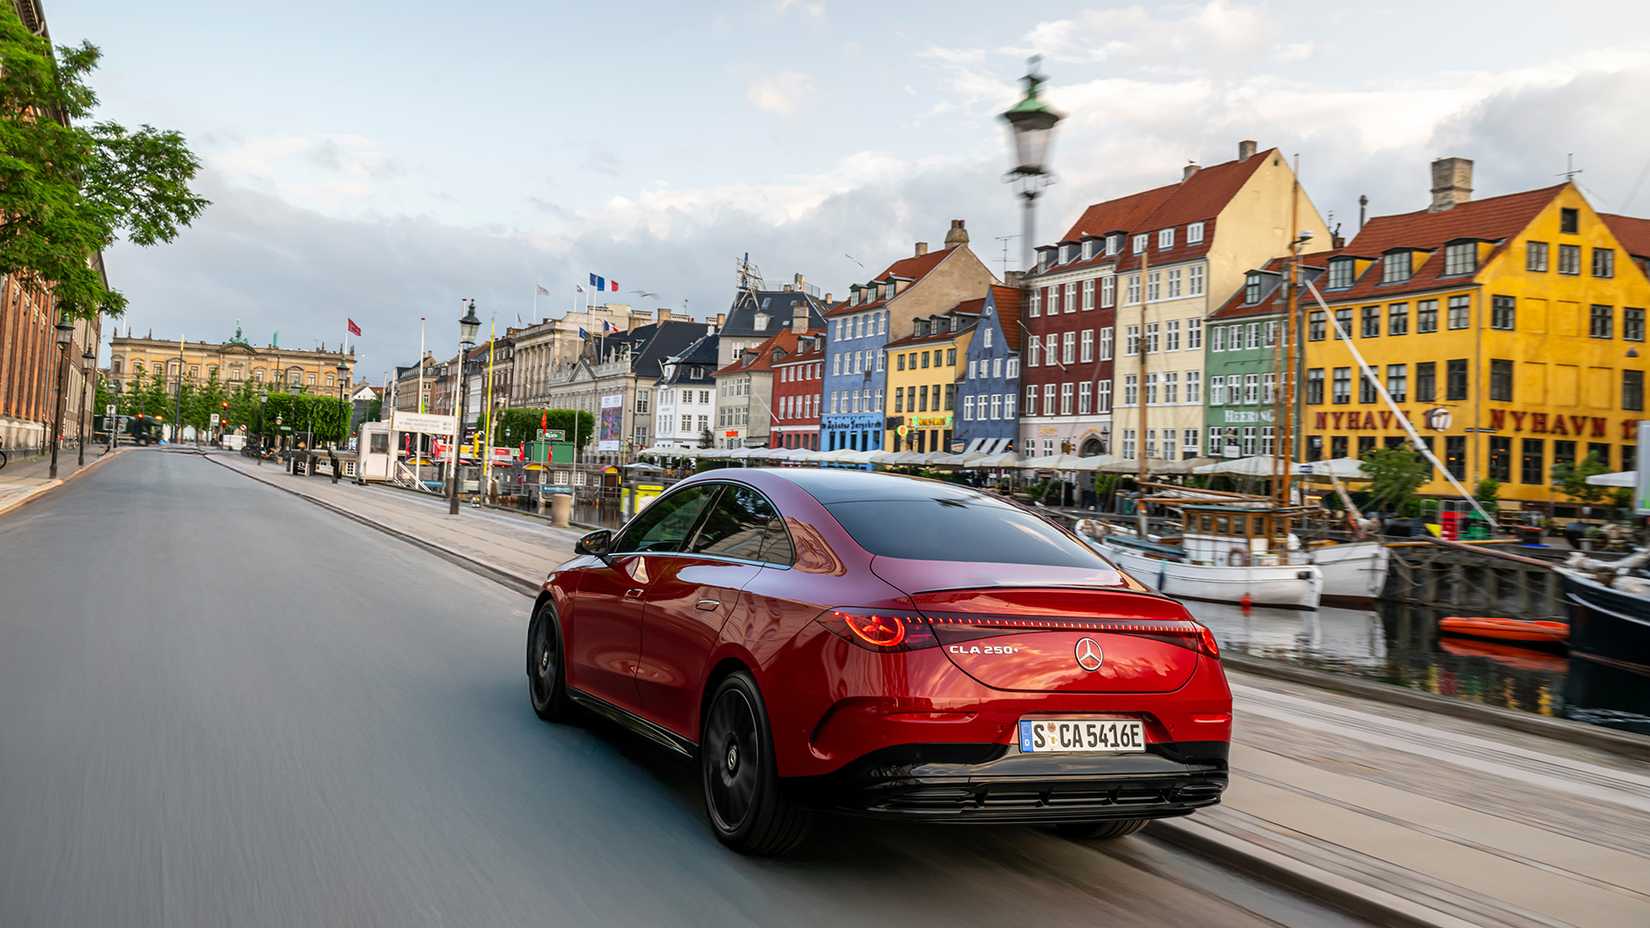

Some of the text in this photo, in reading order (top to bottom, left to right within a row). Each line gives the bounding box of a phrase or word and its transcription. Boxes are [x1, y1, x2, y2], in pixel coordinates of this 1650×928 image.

[1489, 408, 1607, 438] NYHAVN
[949, 645, 981, 654] CLA
[1033, 723, 1046, 748] S
